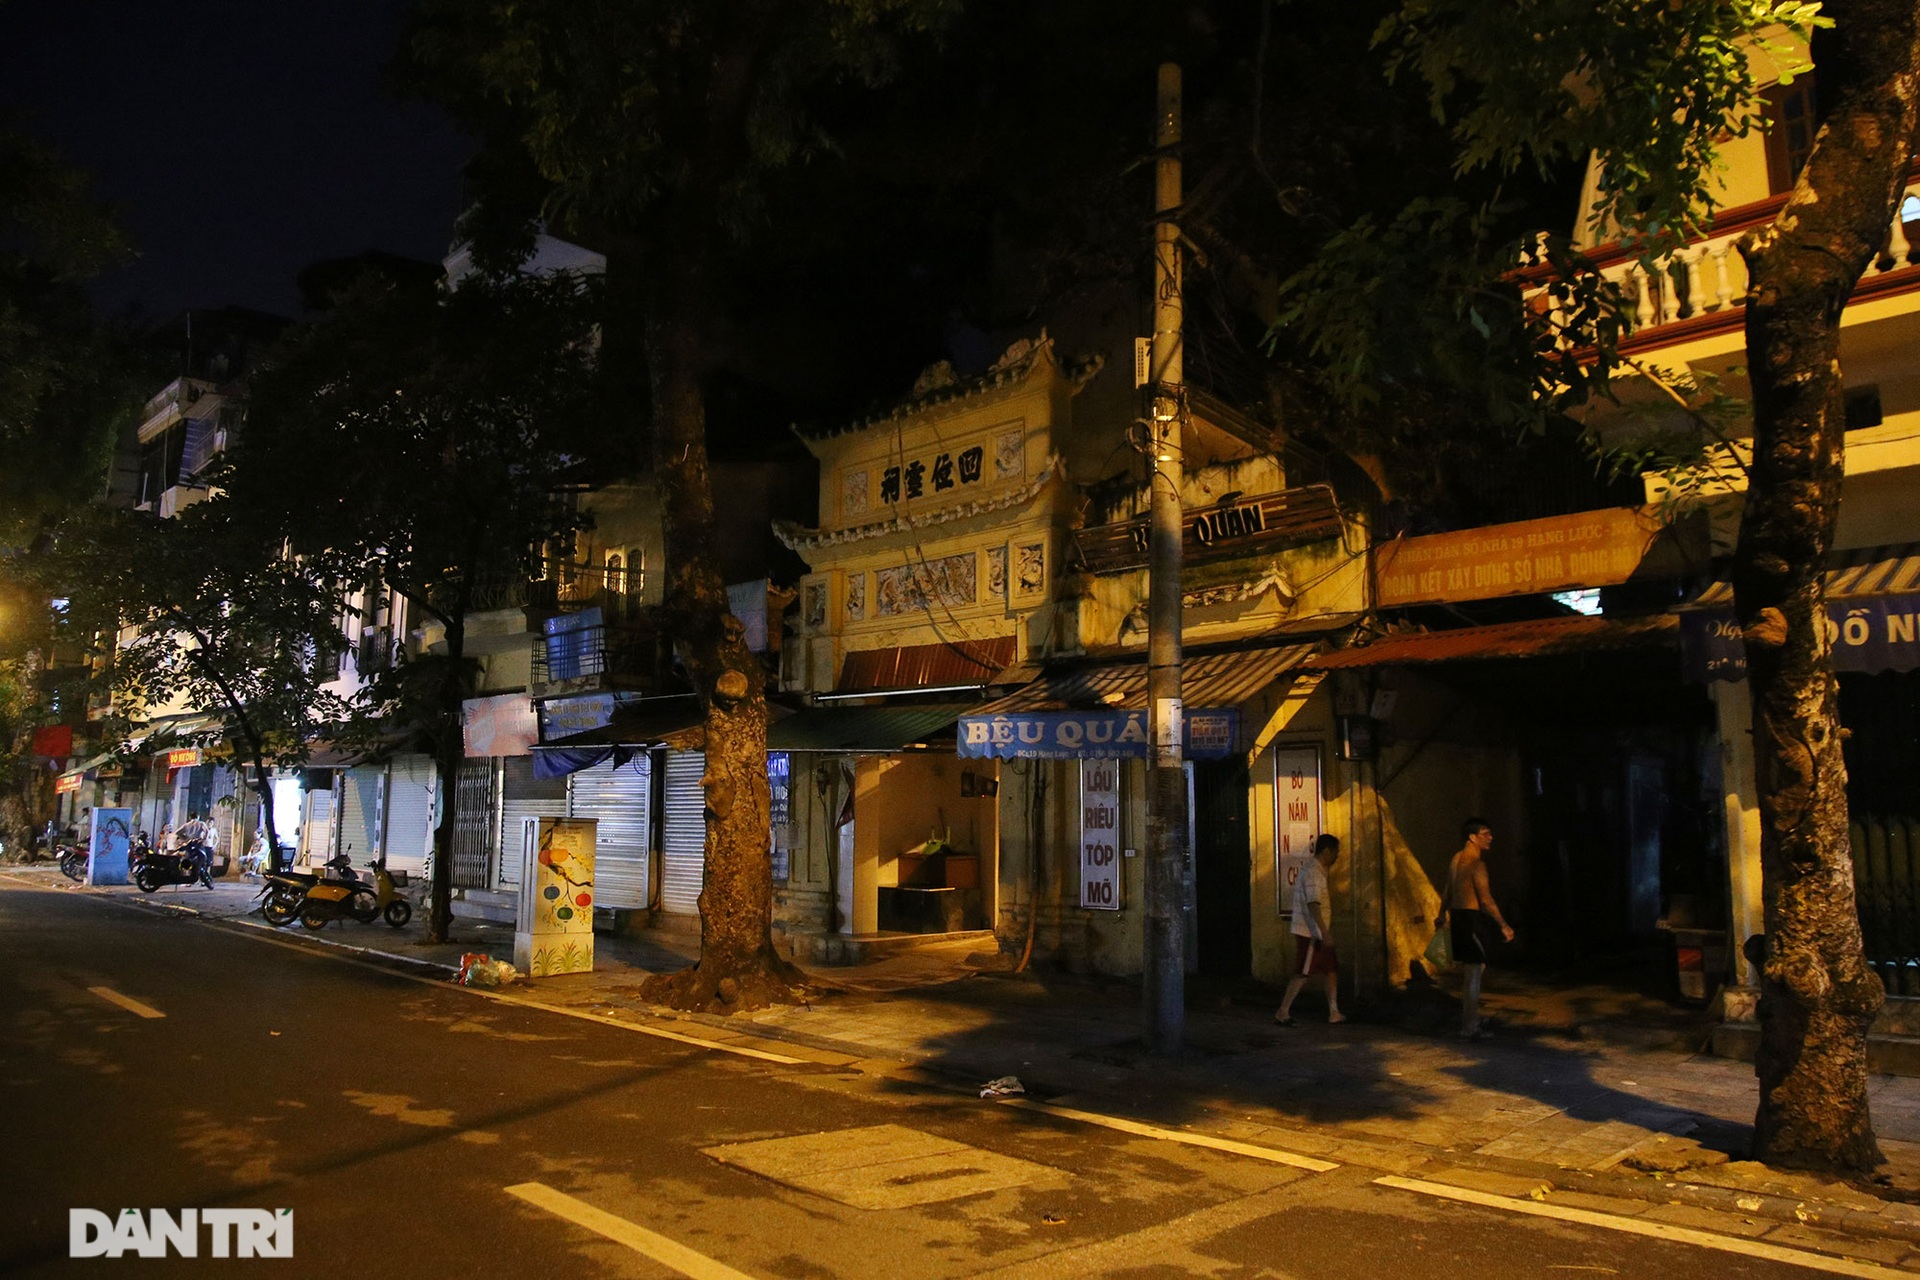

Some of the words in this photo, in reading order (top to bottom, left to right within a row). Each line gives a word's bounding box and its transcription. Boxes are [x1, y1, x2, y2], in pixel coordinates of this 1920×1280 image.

[1514, 552, 1533, 583] SỐ
[1886, 613, 1920, 647] N
[966, 715, 1045, 749] BỆU
[1055, 712, 1148, 749] QUÁ
[1085, 802, 1114, 830] RIÊU
[1085, 840, 1114, 867] TÓP
